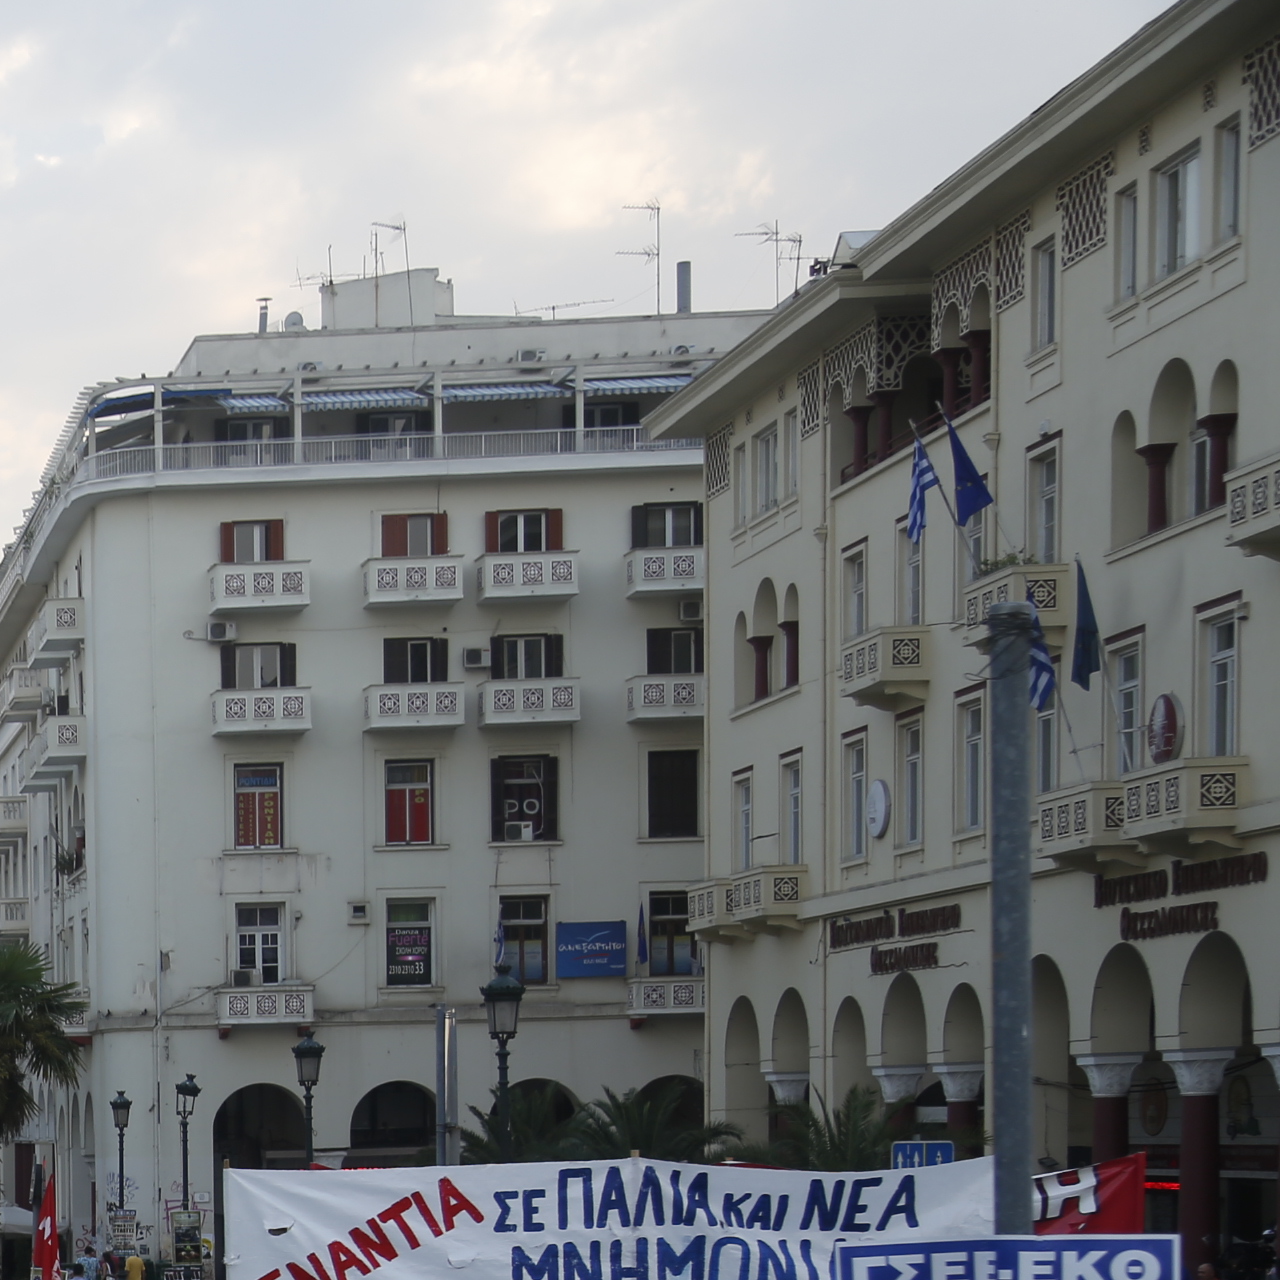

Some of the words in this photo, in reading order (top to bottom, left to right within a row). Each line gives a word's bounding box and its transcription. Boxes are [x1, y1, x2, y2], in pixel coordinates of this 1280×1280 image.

[493, 1189, 547, 1233] ΣΕ
[557, 1165, 709, 1231] ΠΑΛΙΑ
[800, 1175, 920, 1233] ΝΕΑ
